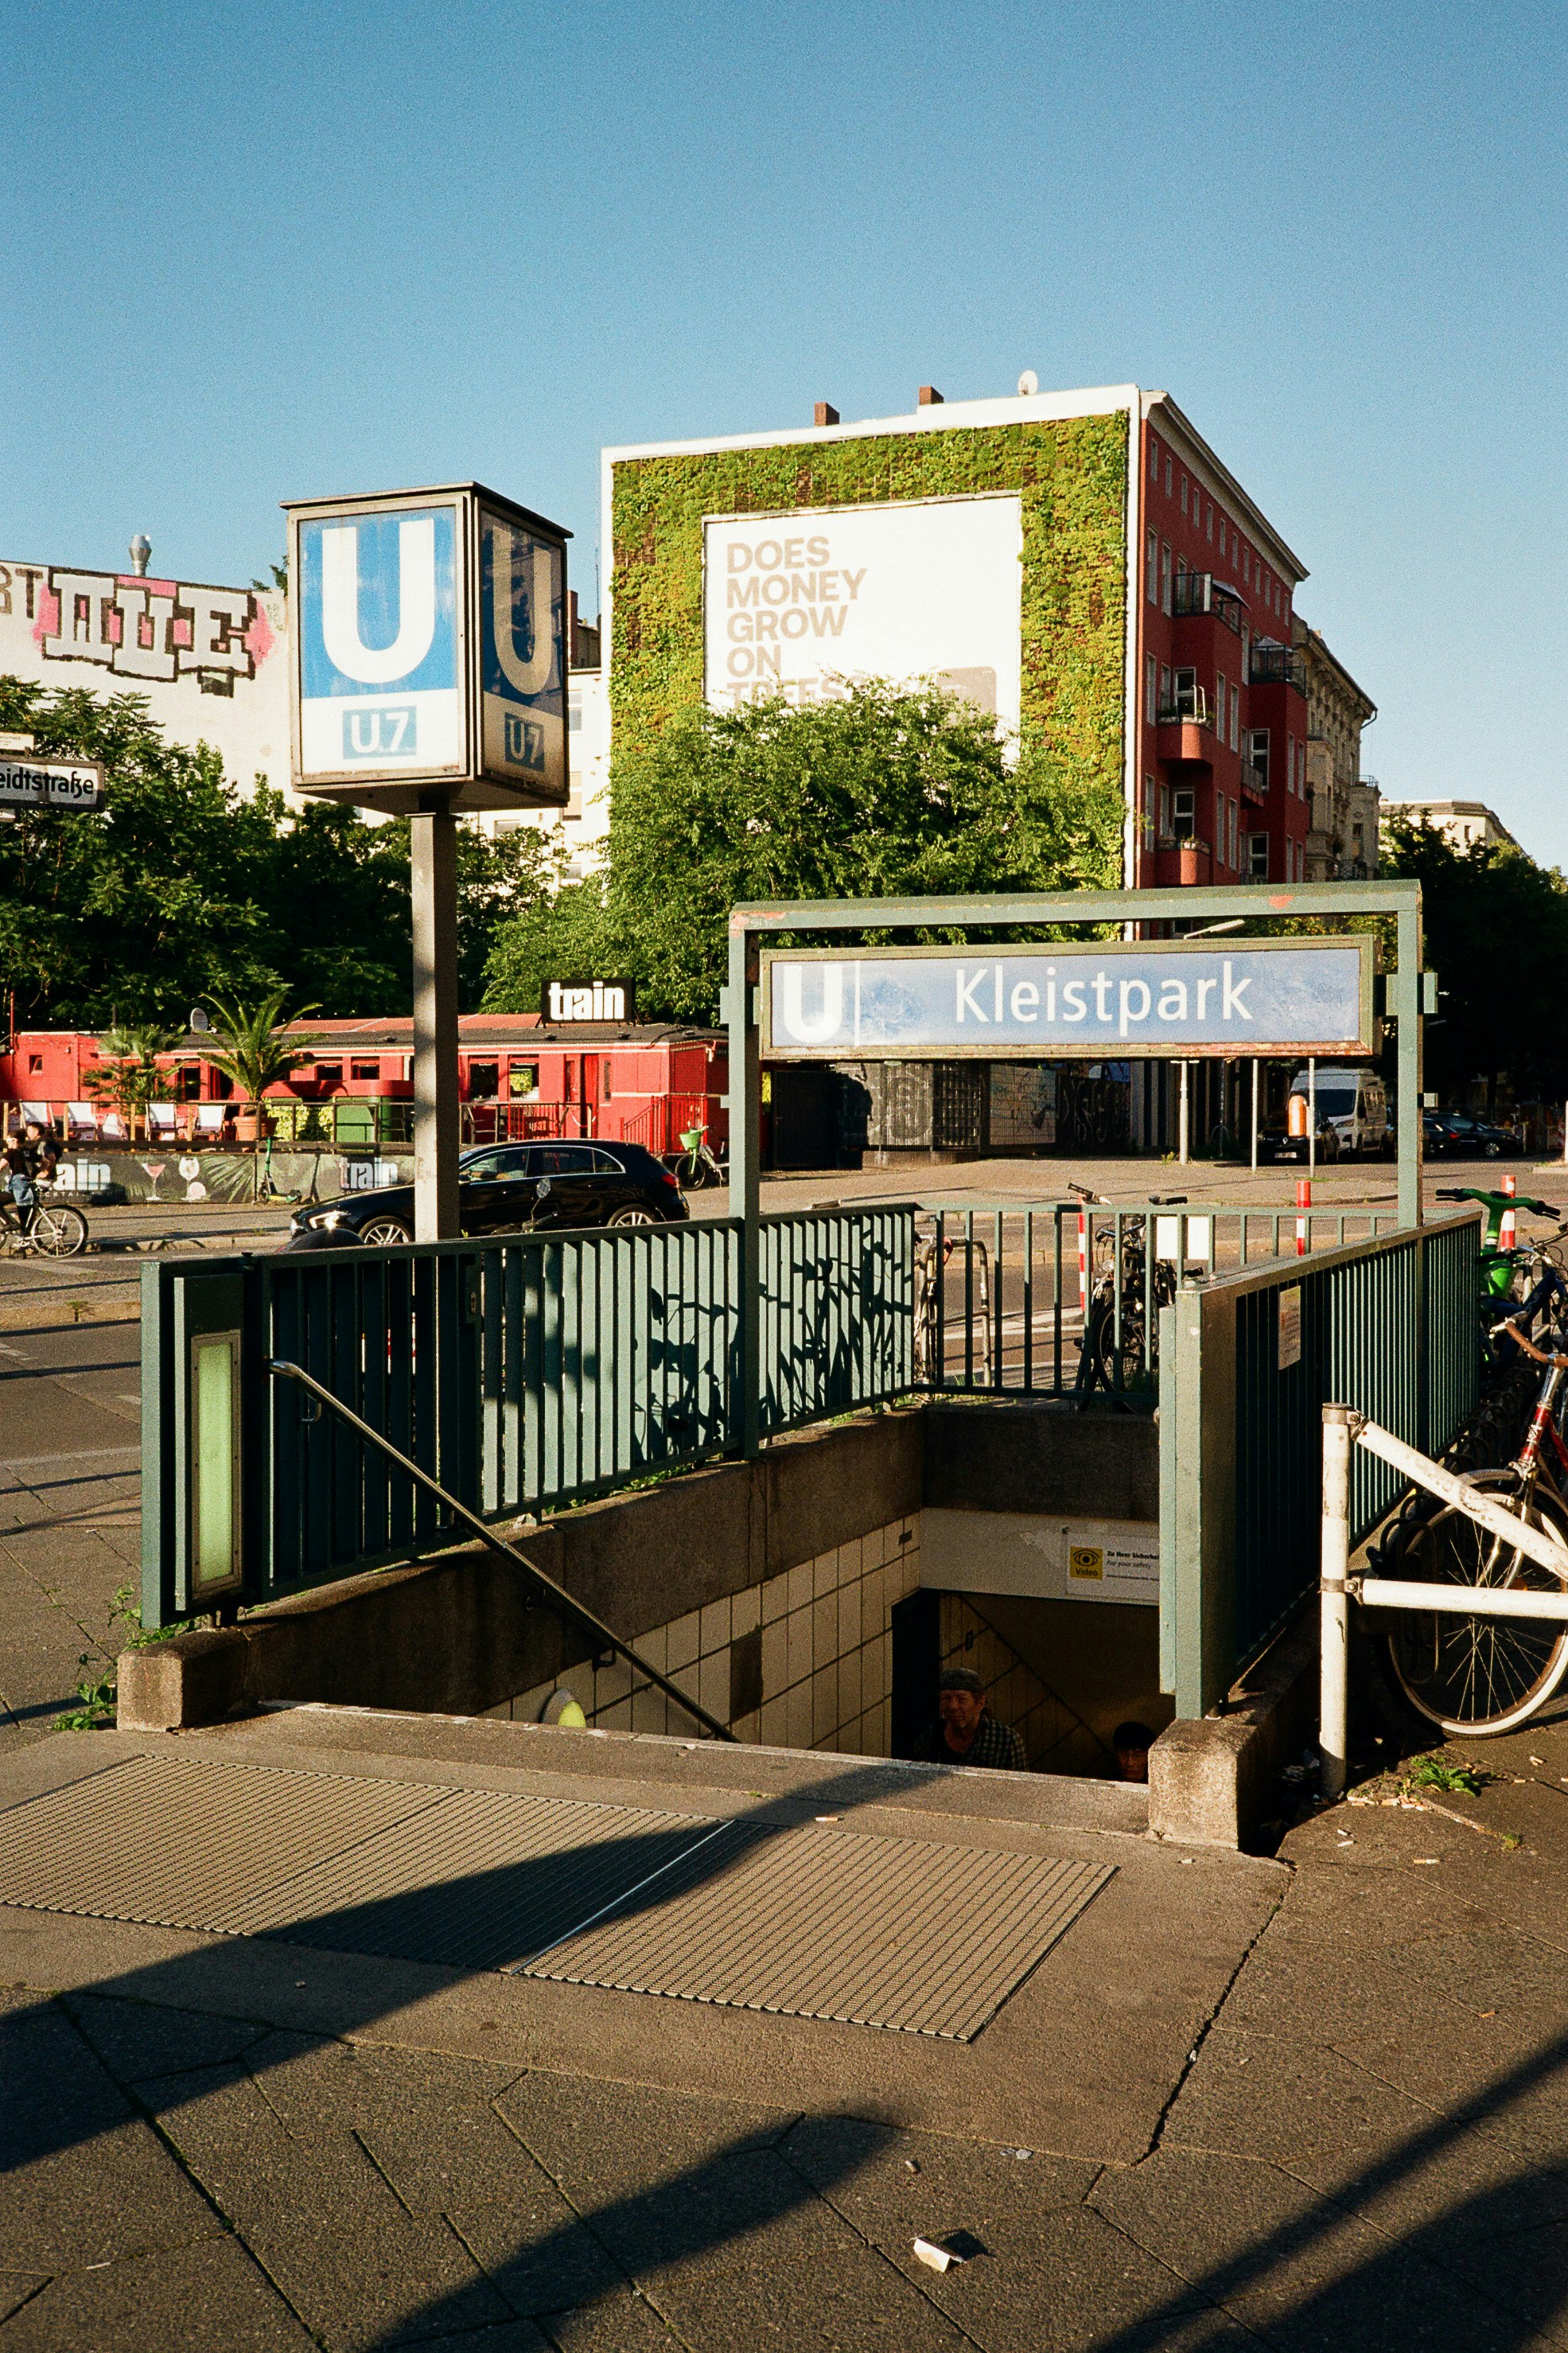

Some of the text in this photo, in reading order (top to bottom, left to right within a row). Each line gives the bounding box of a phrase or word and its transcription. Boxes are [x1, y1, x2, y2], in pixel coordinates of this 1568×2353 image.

[726, 536, 831, 574] DOES
[322, 519, 434, 684] U
[726, 568, 867, 609] MONEY
[492, 525, 552, 695] U
[726, 605, 848, 643] GROW
[726, 645, 781, 677] ON
[350, 711, 410, 753] U7
[508, 719, 540, 764] U7
[548, 981, 624, 1020] train
[783, 961, 1254, 1043] U Kleistpark
[1075, 1568, 1099, 1576] Video
